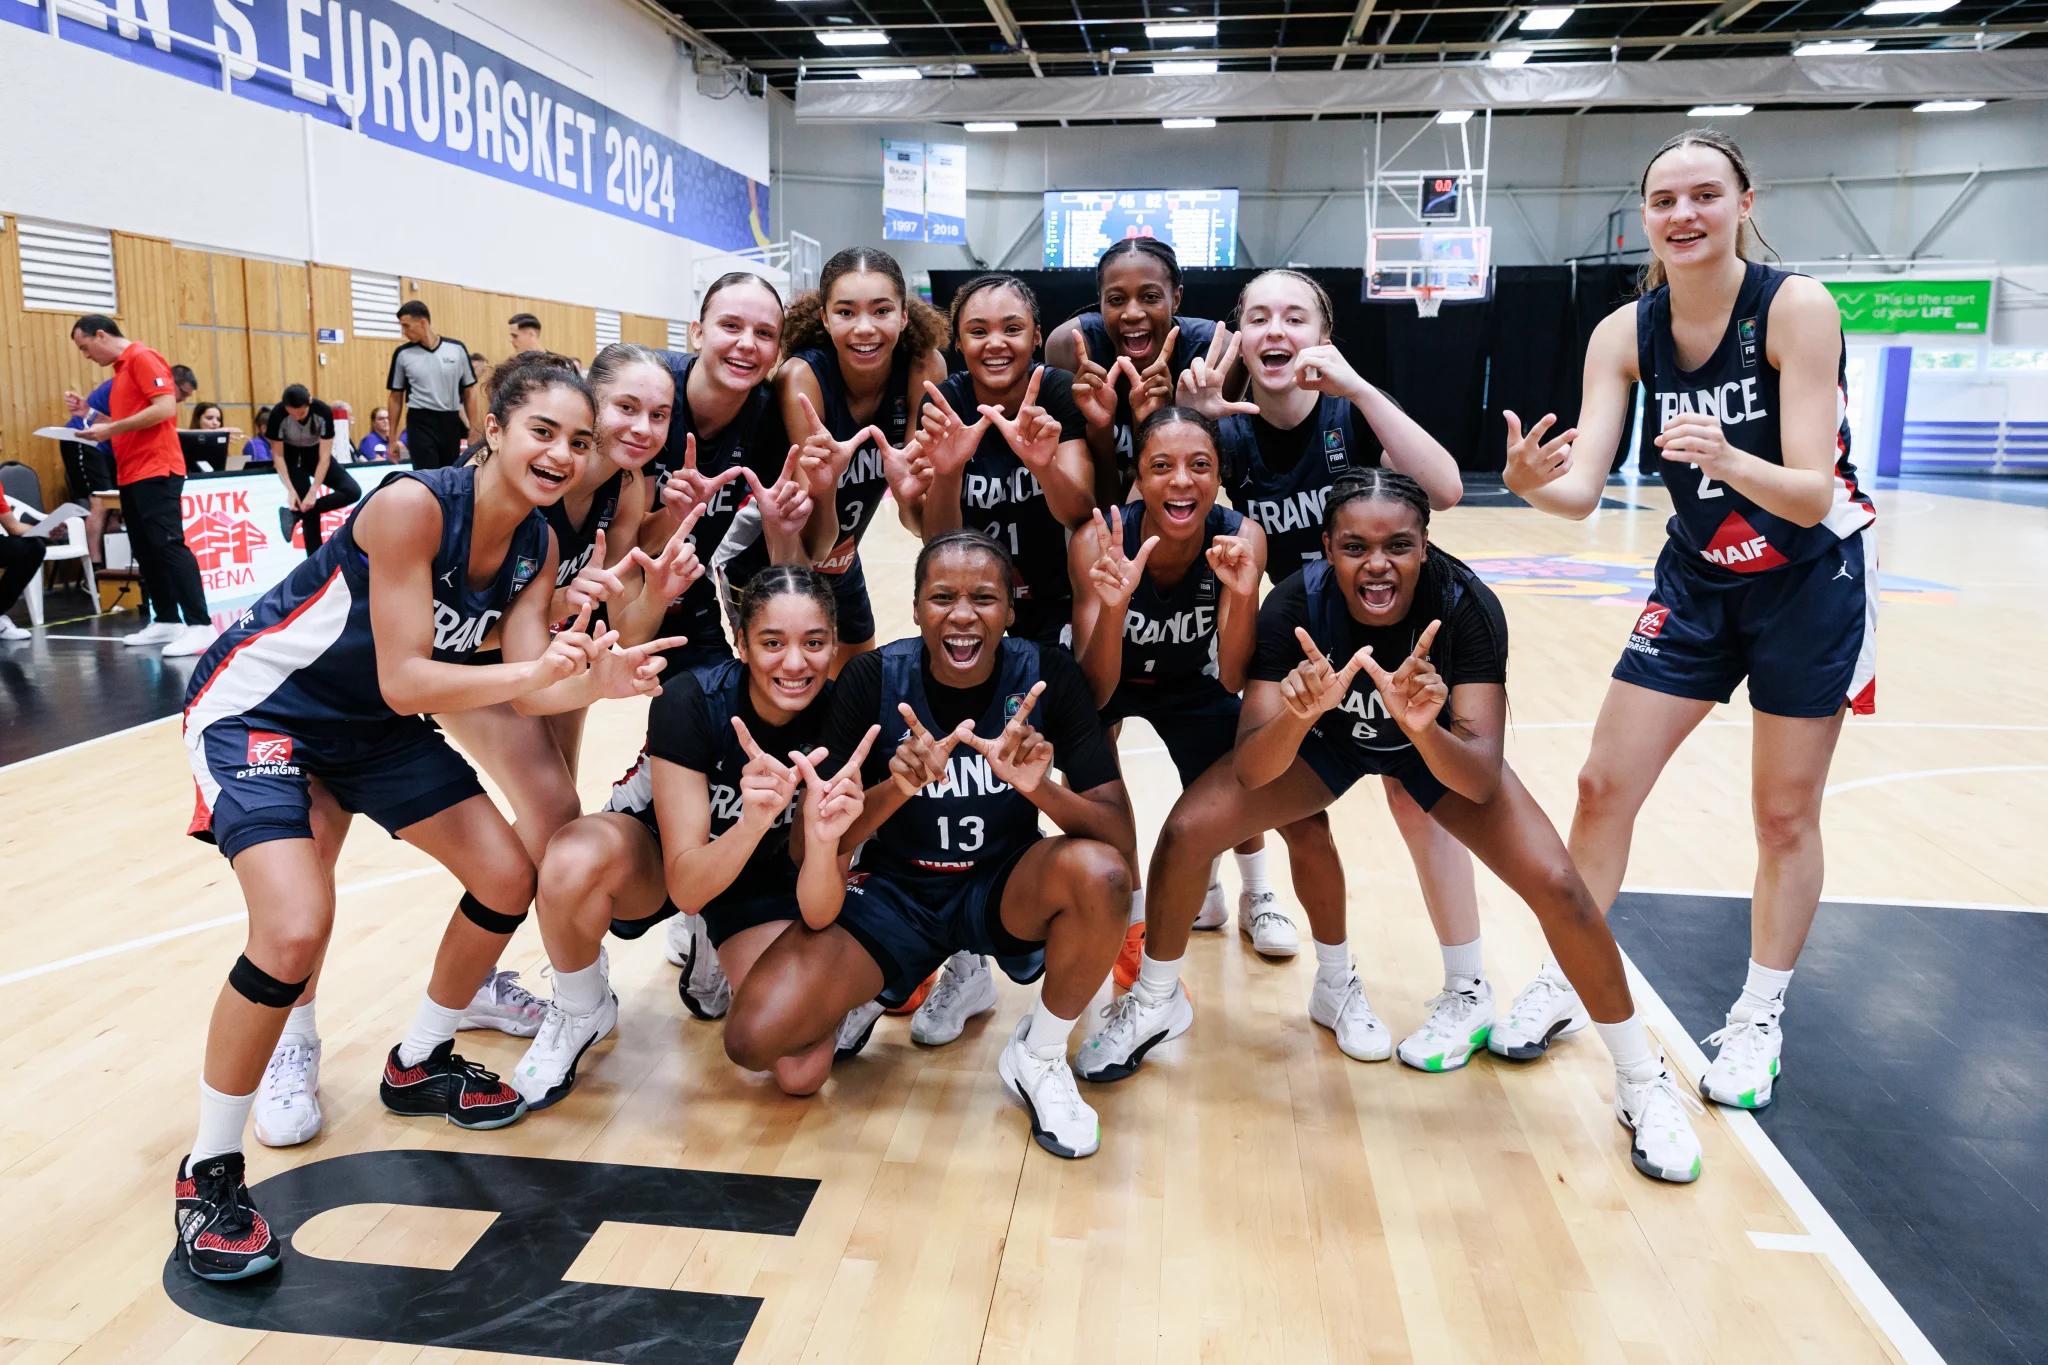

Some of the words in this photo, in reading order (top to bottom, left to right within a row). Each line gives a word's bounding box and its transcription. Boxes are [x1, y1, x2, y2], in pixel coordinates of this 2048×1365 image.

[286, 0, 597, 195] EUROBASKET
[605, 126, 676, 223] 2024
[1874, 293, 1902, 305] This
[1904, 294, 1914, 305] is
[1917, 293, 1936, 305] the
[1943, 295, 1976, 305] start
[1872, 308, 1886, 318] of
[1888, 310, 1919, 321] your
[840, 500, 864, 532] 3
[1247, 486, 1333, 535] FRANC
[1700, 535, 1768, 565] MAIF
[1122, 605, 1216, 646] RANCE
[1143, 659, 1156, 673] 1
[1352, 721, 1378, 739] 6
[236, 765, 301, 779] D'EPARGNE
[937, 815, 985, 852] 13
